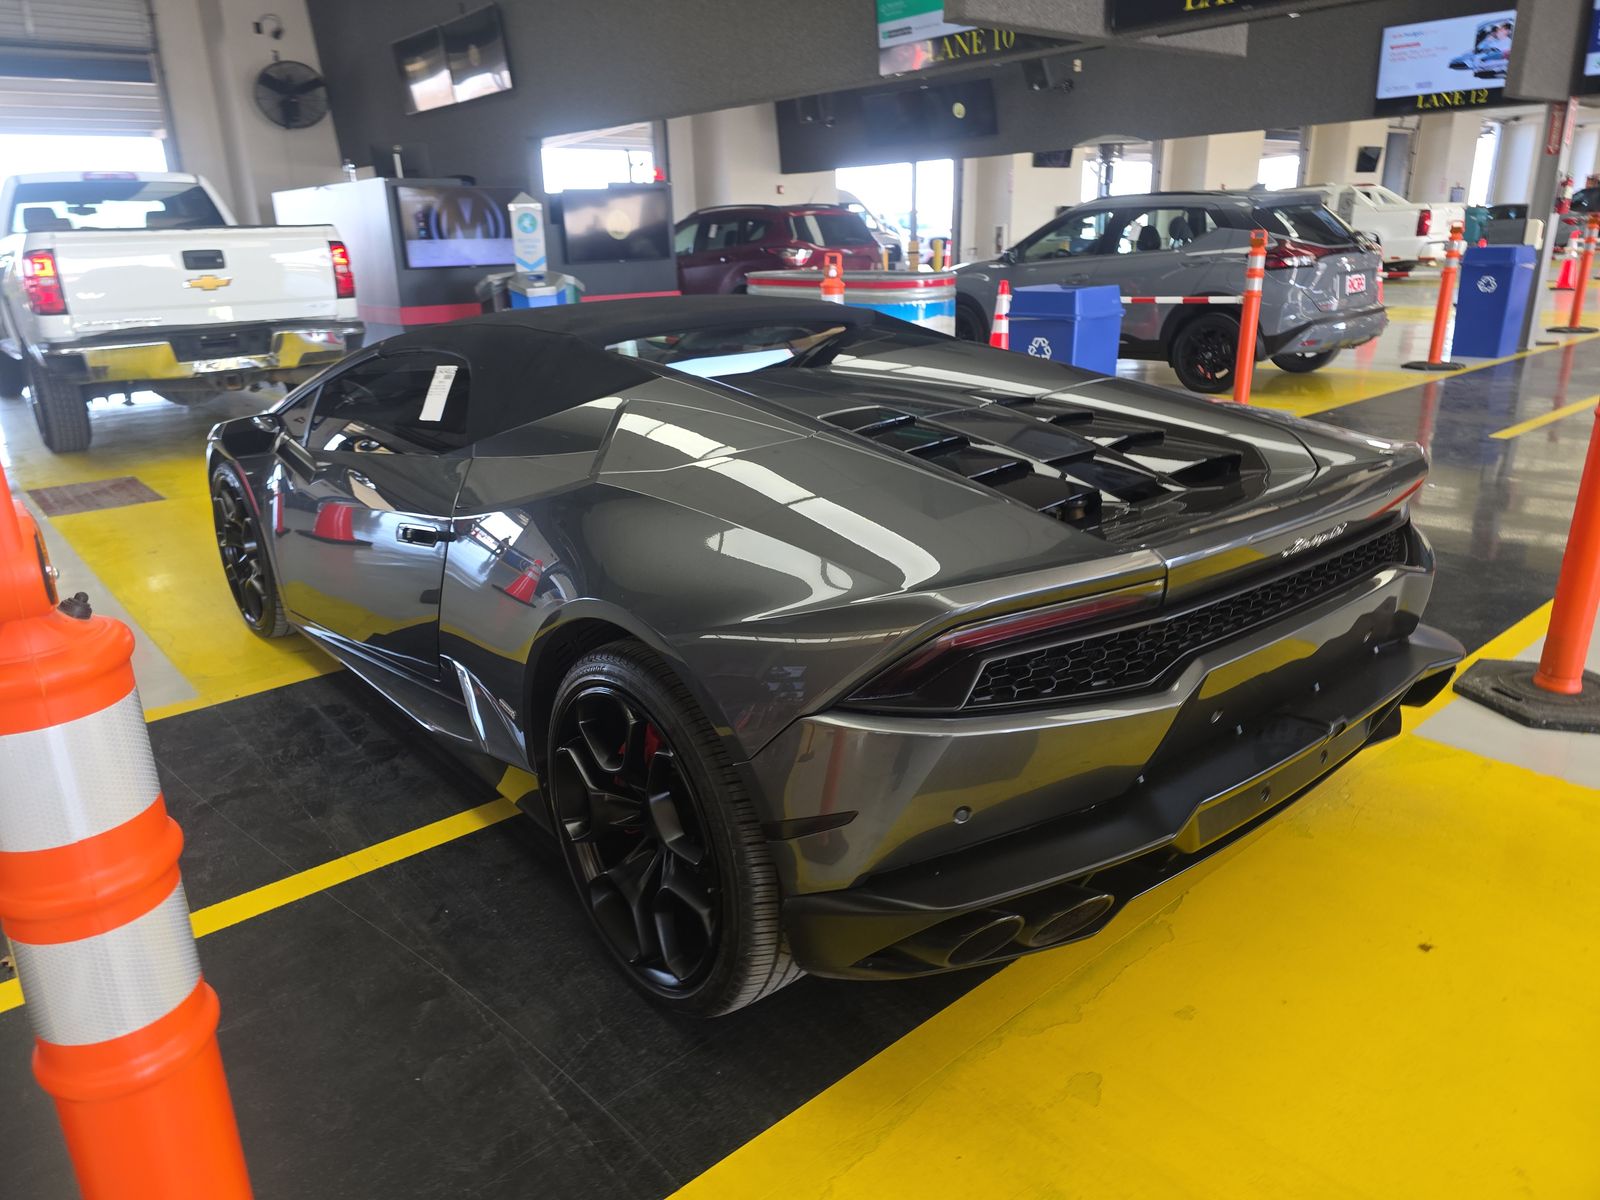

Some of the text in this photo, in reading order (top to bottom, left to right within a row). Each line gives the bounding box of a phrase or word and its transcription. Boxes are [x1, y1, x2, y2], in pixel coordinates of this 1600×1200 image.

[926, 28, 986, 61] LANE
[993, 28, 1014, 50] 10
[1417, 88, 1488, 108] LANE 12
